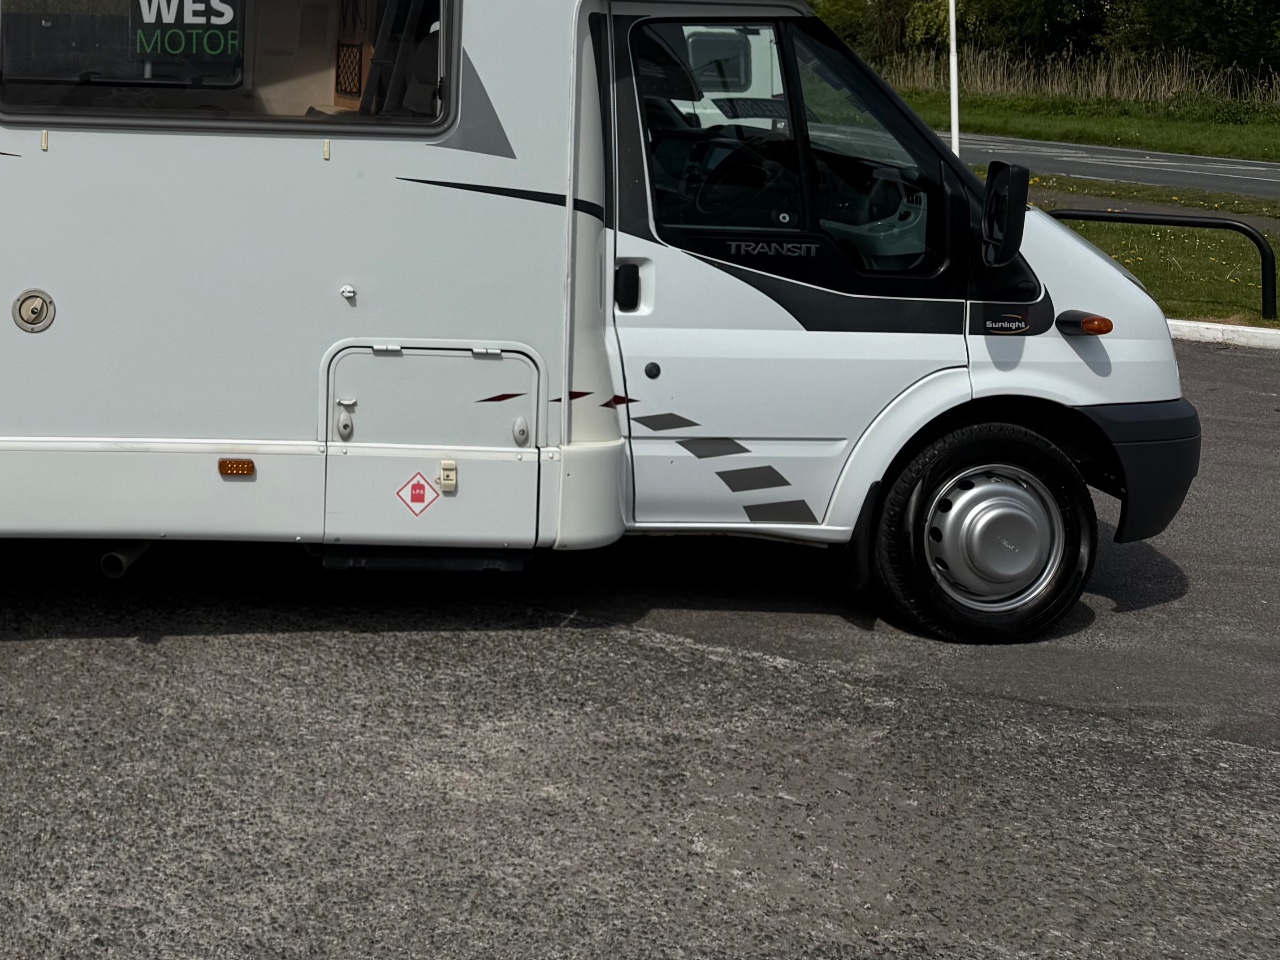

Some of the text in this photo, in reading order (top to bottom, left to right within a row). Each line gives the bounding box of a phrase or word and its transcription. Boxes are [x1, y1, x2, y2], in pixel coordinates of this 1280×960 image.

[136, 28, 239, 55] MOTOR
[726, 241, 820, 257] TRANSIT
[986, 321, 1026, 329] Sunlight
